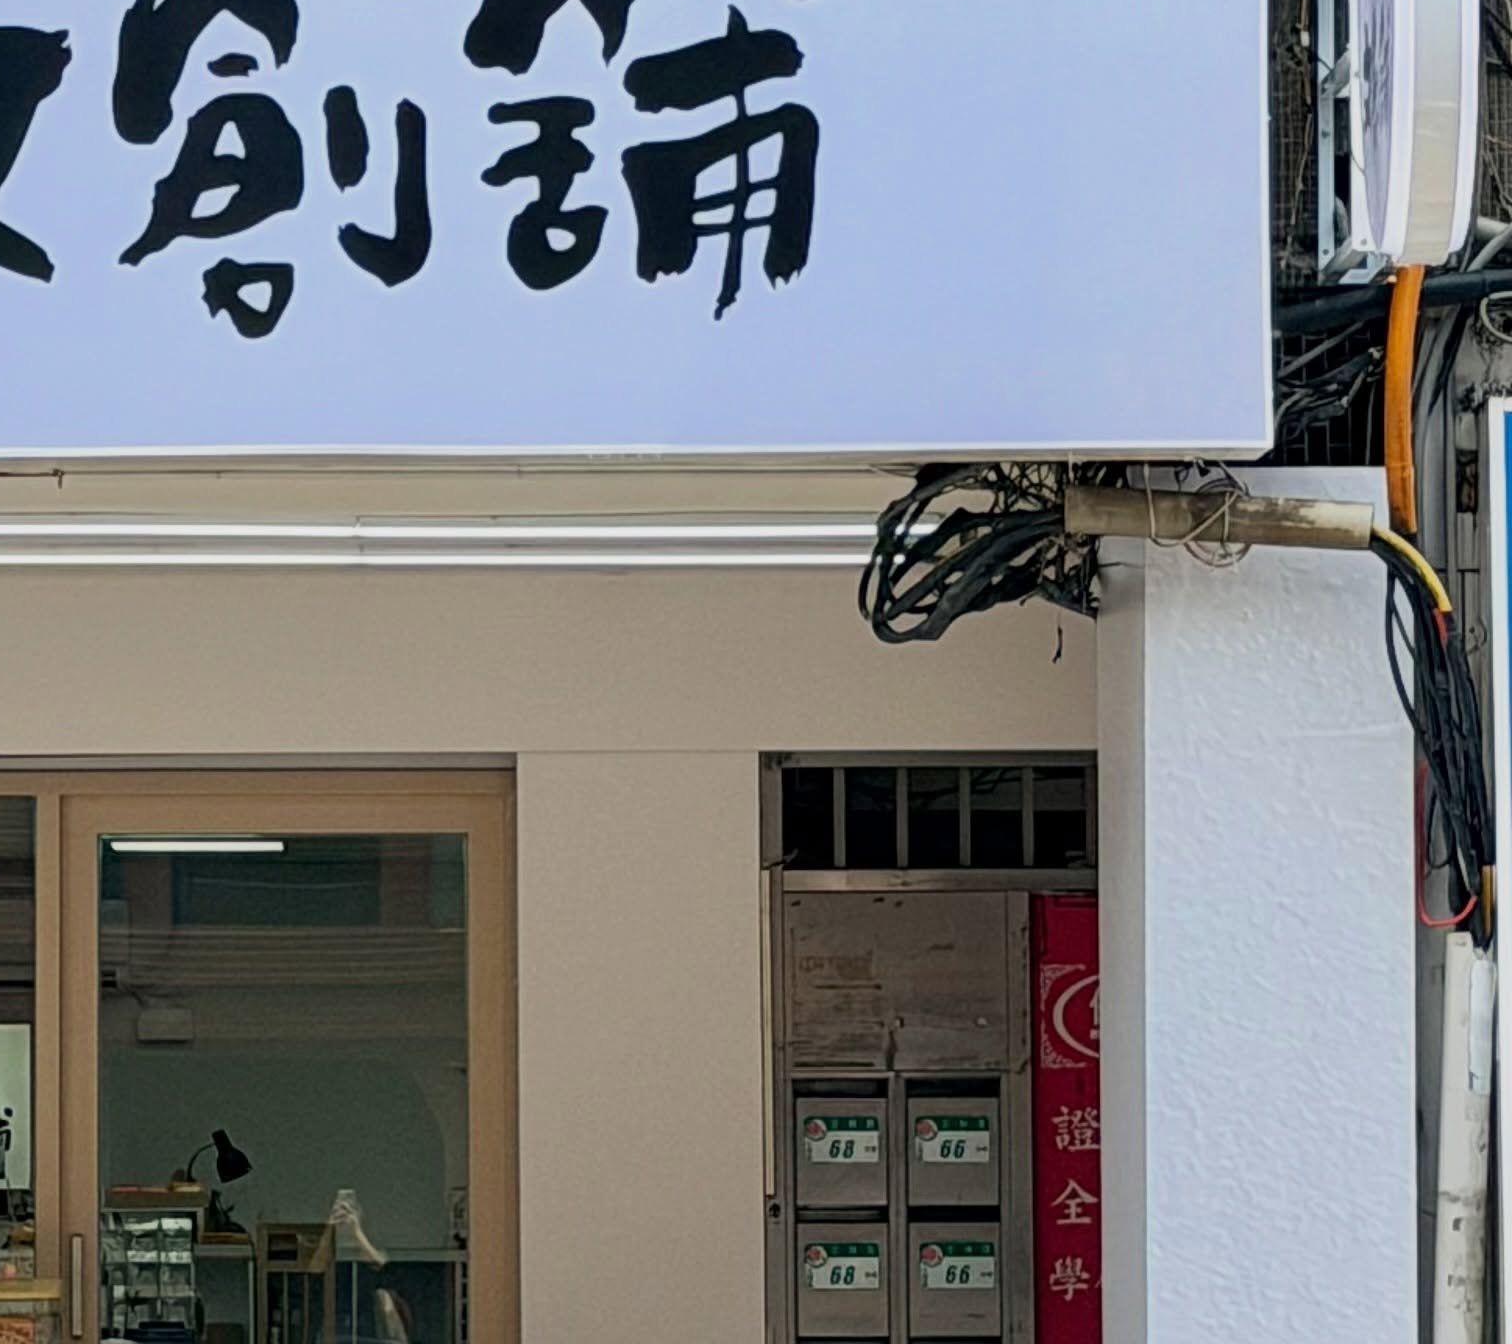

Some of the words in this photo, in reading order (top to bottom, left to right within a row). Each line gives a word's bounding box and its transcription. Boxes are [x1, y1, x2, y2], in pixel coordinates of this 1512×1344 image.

[829, 1140, 855, 1159] 68
[940, 1139, 967, 1159] 66
[830, 1266, 856, 1286] 68
[945, 1265, 971, 1285] 66
